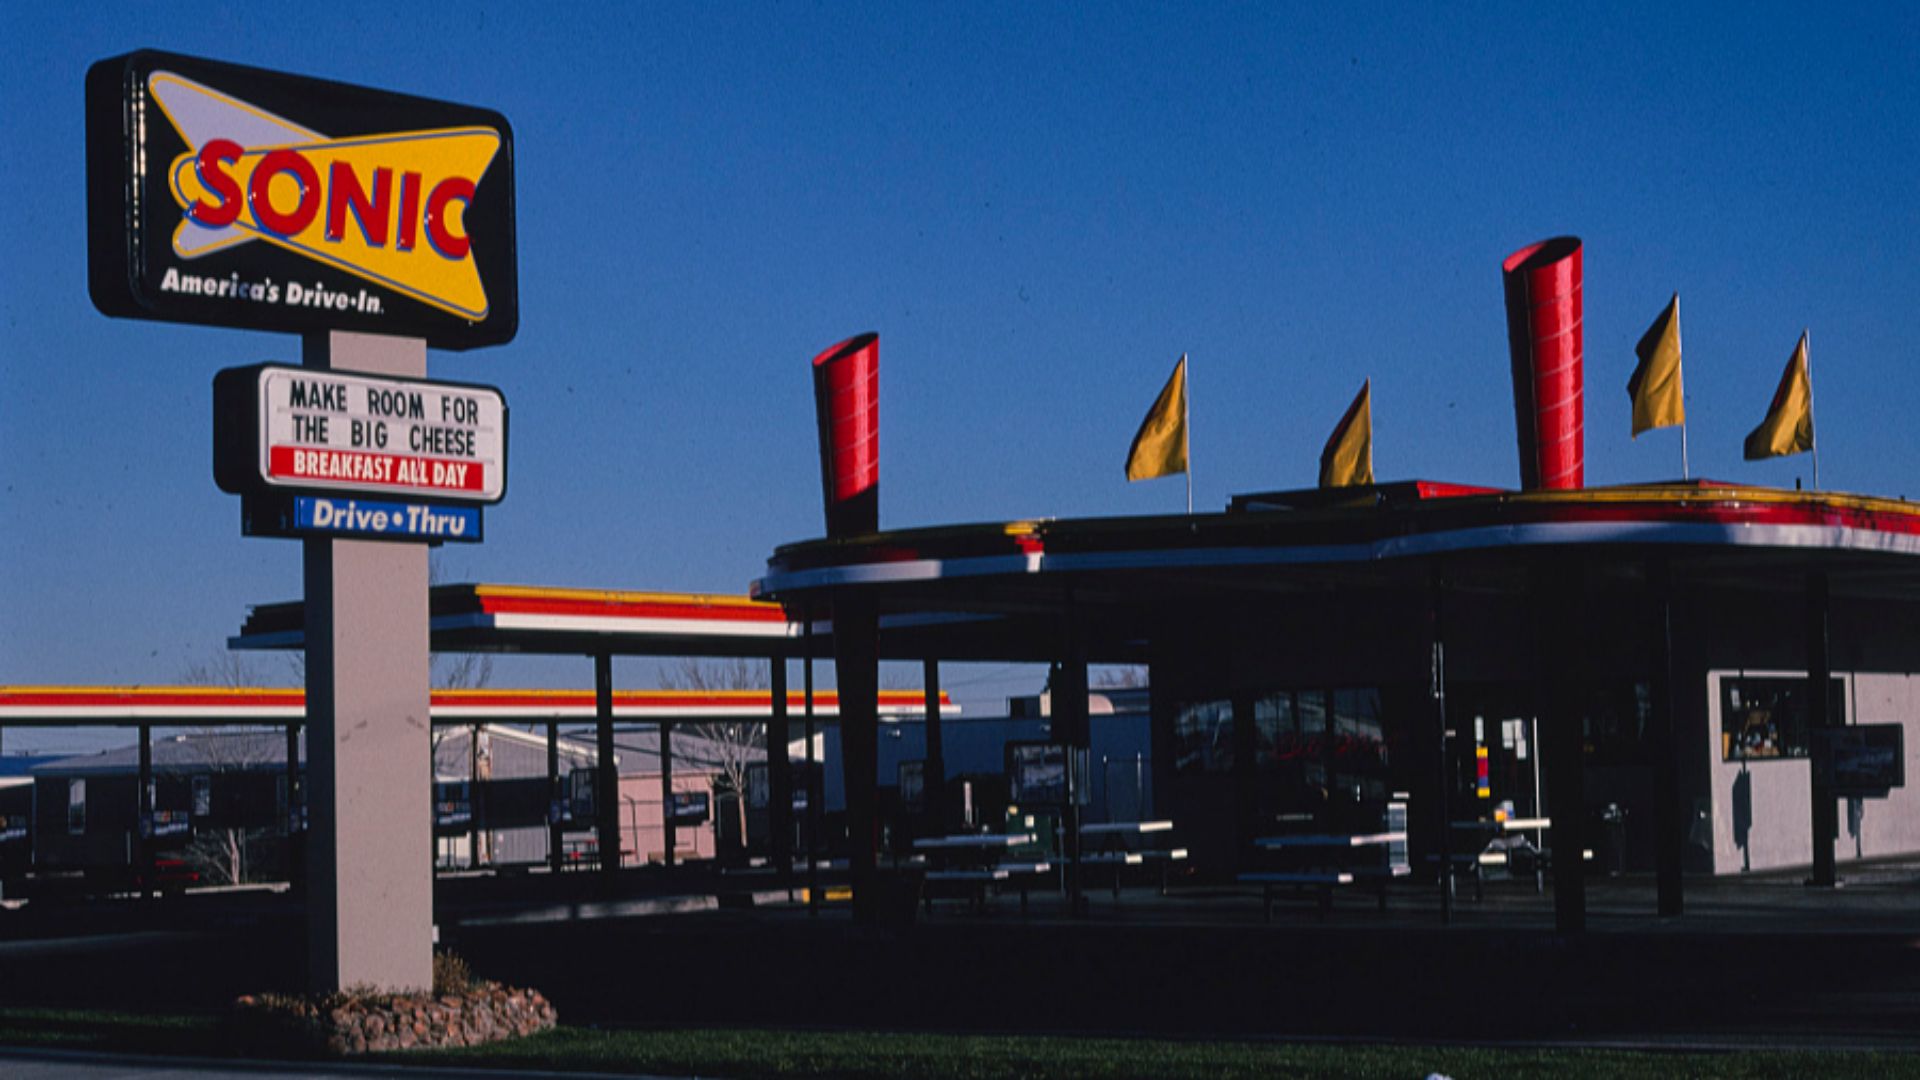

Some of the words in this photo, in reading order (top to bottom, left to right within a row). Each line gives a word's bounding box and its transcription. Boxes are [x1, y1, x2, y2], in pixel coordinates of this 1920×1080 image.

[184, 138, 476, 260] SONIC
[161, 268, 280, 303] America's
[289, 380, 348, 412] MAKE
[367, 388, 424, 417] ROOM
[441, 396, 478, 424] FOR
[292, 415, 329, 443] THE
[351, 423, 388, 448] BIG
[409, 424, 476, 457] CHEESE
[293, 450, 393, 482] BREAKFAST
[397, 458, 429, 487] ALL
[432, 463, 468, 487] DAY
